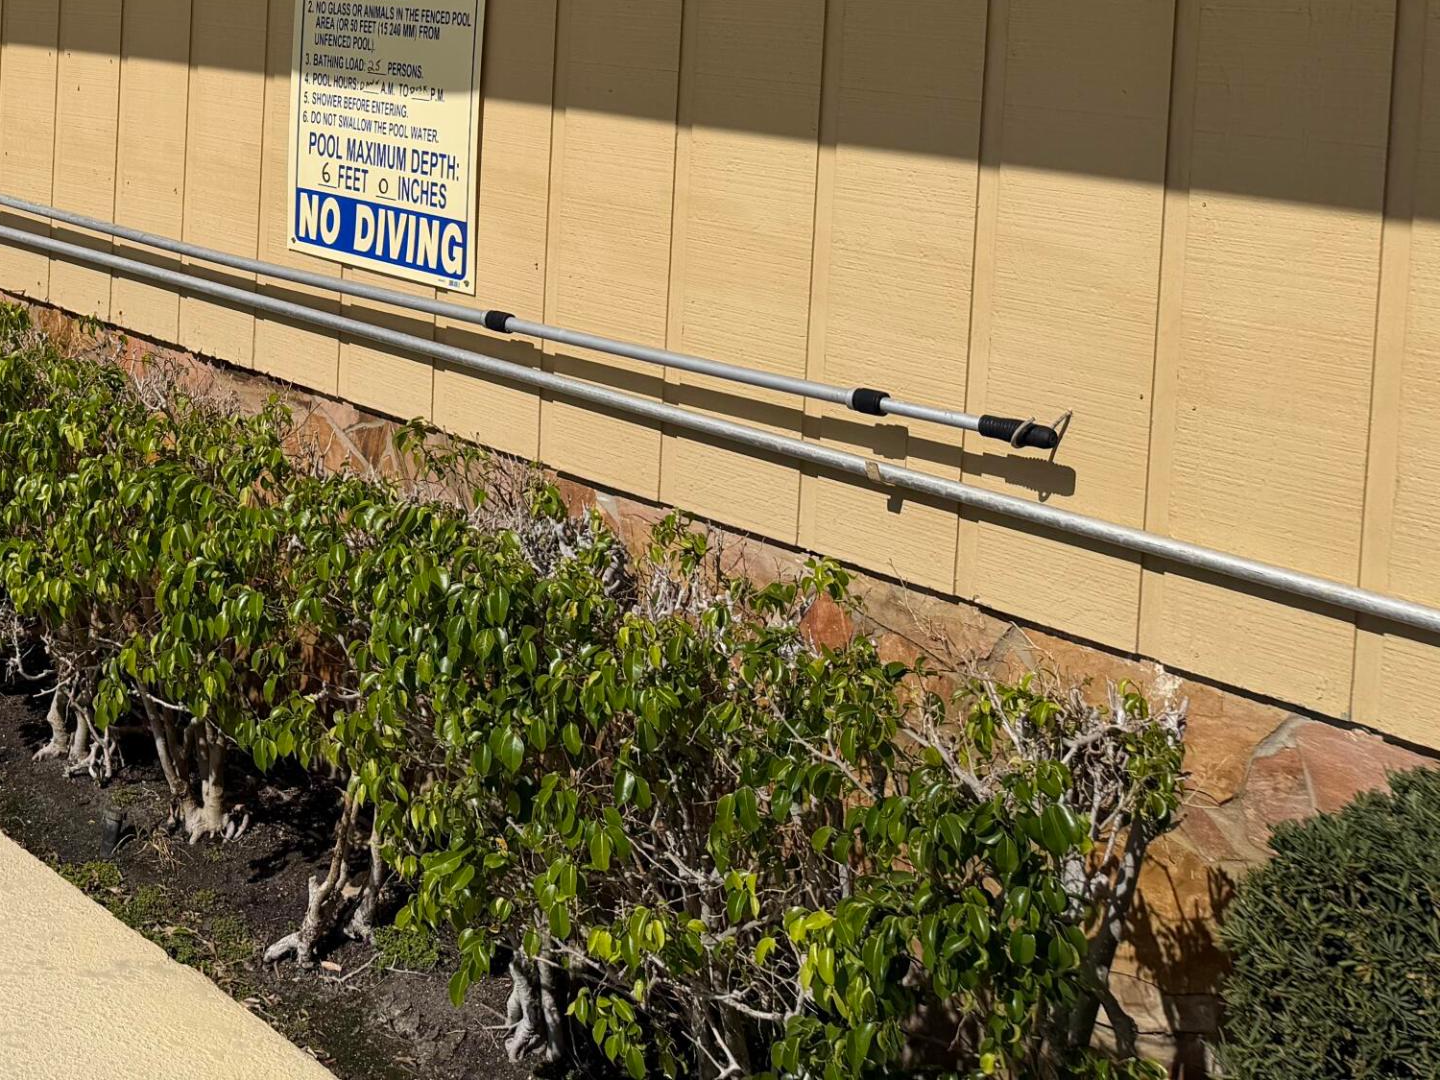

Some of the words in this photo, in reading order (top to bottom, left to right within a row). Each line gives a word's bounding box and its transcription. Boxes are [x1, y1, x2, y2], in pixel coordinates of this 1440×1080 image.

[308, 0, 314, 13] 2.
[316, 1, 326, 14] NO
[328, 2, 351, 16] GLASS
[352, 3, 362, 17] OR
[364, 5, 394, 19] ANIMALS
[396, 8, 403, 21] IN
[405, 8, 419, 22] THE
[421, 9, 450, 24] FENCED
[452, 11, 471, 26] POOL
[314, 33, 351, 48] UNFENCED
[316, 16, 334, 30] AREA
[337, 18, 349, 33] (OR
[350, 19, 358, 32] 50
[360, 20, 376, 33] FEET
[378, 22, 388, 37] (15
[389, 23, 400, 36] 240
[403, 24, 417, 41] MM)
[419, 26, 440, 40] FROM
[306, 53, 311, 65] 3.
[313, 54, 343, 68] BATHING
[345, 57, 366, 71] LOAD:
[368, 60, 381, 71] 25
[388, 62, 423, 79] PERSONS.
[305, 72, 310, 84] 4.
[313, 73, 332, 87] POOL
[334, 75, 358, 90] HOURS:
[399, 83, 409, 97] TO
[431, 88, 445, 102] P.M.
[304, 92, 309, 104] 5.
[312, 92, 342, 108] SHOWER
[344, 97, 370, 112] BEFORE
[372, 101, 408, 118] ENTERING.
[303, 111, 308, 122] 6.
[311, 111, 321, 124] DO
[323, 113, 336, 126] NOT
[339, 115, 372, 132] SWALLOW
[374, 120, 386, 134] THE
[389, 122, 408, 138] POOL
[411, 126, 439, 143] WATER.
[309, 132, 342, 159] POOL
[346, 138, 406, 172] MAXIMUM
[411, 149, 459, 181] DEPTH:
[322, 162, 331, 183] 6
[337, 164, 369, 193] FEET
[398, 176, 447, 209] INCHES
[299, 192, 340, 245] NO
[353, 204, 464, 275] DIVING
